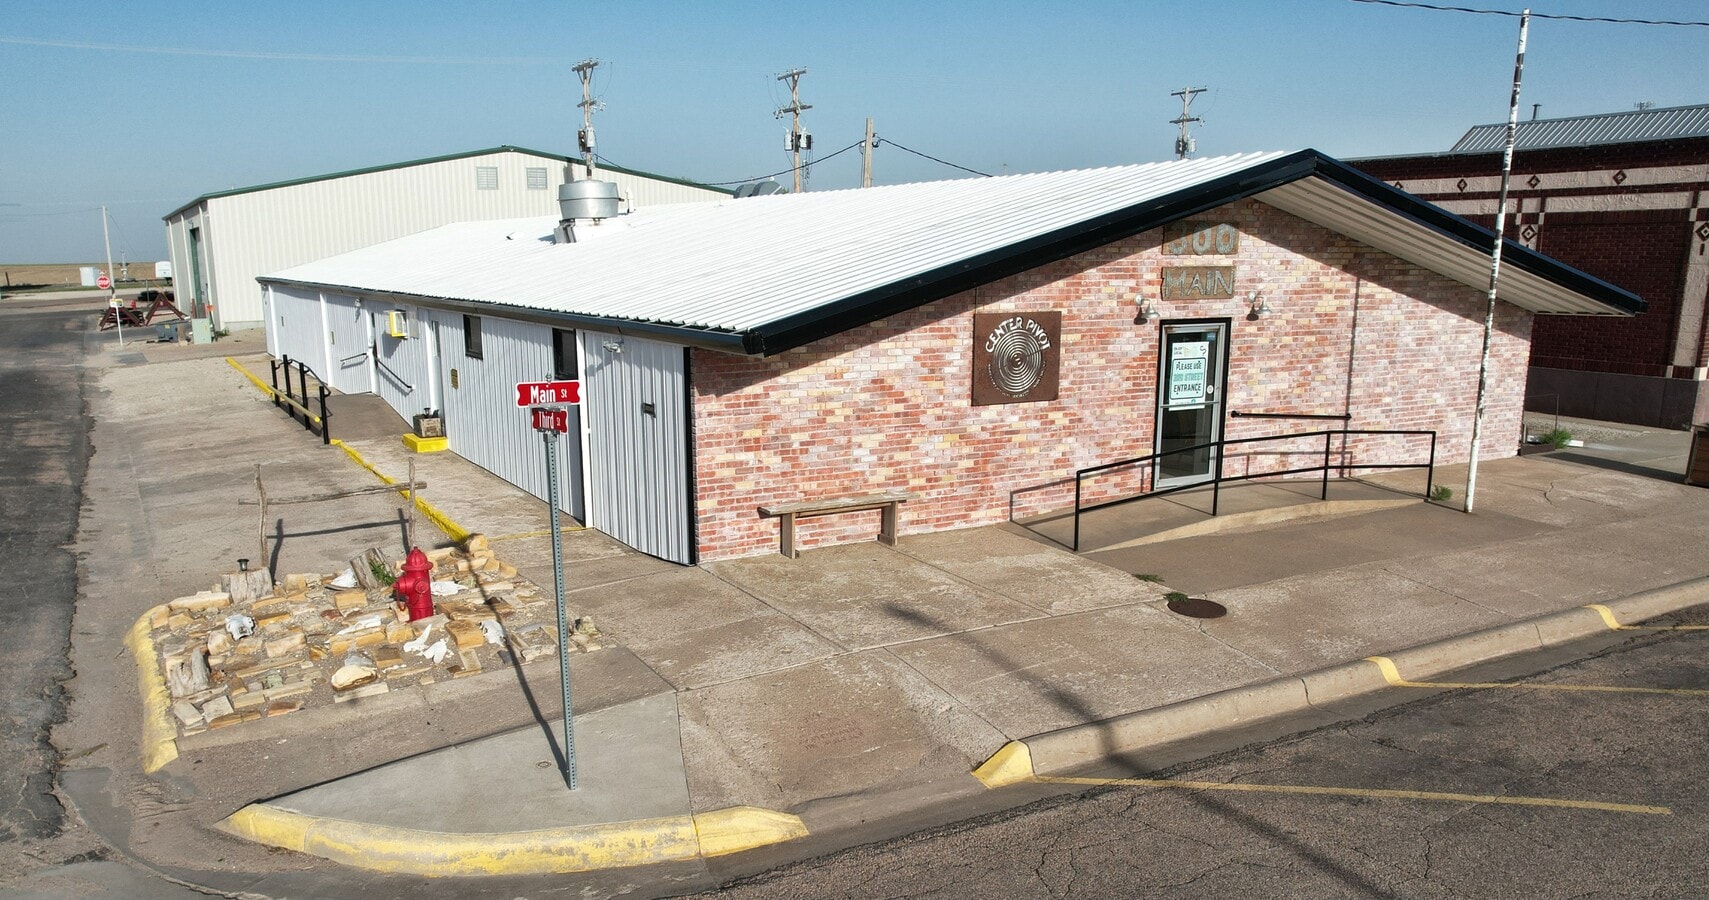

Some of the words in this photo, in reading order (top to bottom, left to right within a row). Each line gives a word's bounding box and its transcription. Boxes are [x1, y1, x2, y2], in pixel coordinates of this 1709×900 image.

[1164, 270, 1234, 298] MAIN
[985, 317, 1023, 353] CENTER
[1026, 319, 1052, 350] PIVOT
[1176, 362, 1192, 370] PLEASE
[1194, 361, 1202, 369] USE
[1185, 373, 1203, 381] STREET
[530, 385, 556, 404] Main
[561, 389, 568, 398] St
[1174, 384, 1202, 392] ENTRANCE
[538, 411, 555, 429] Third
